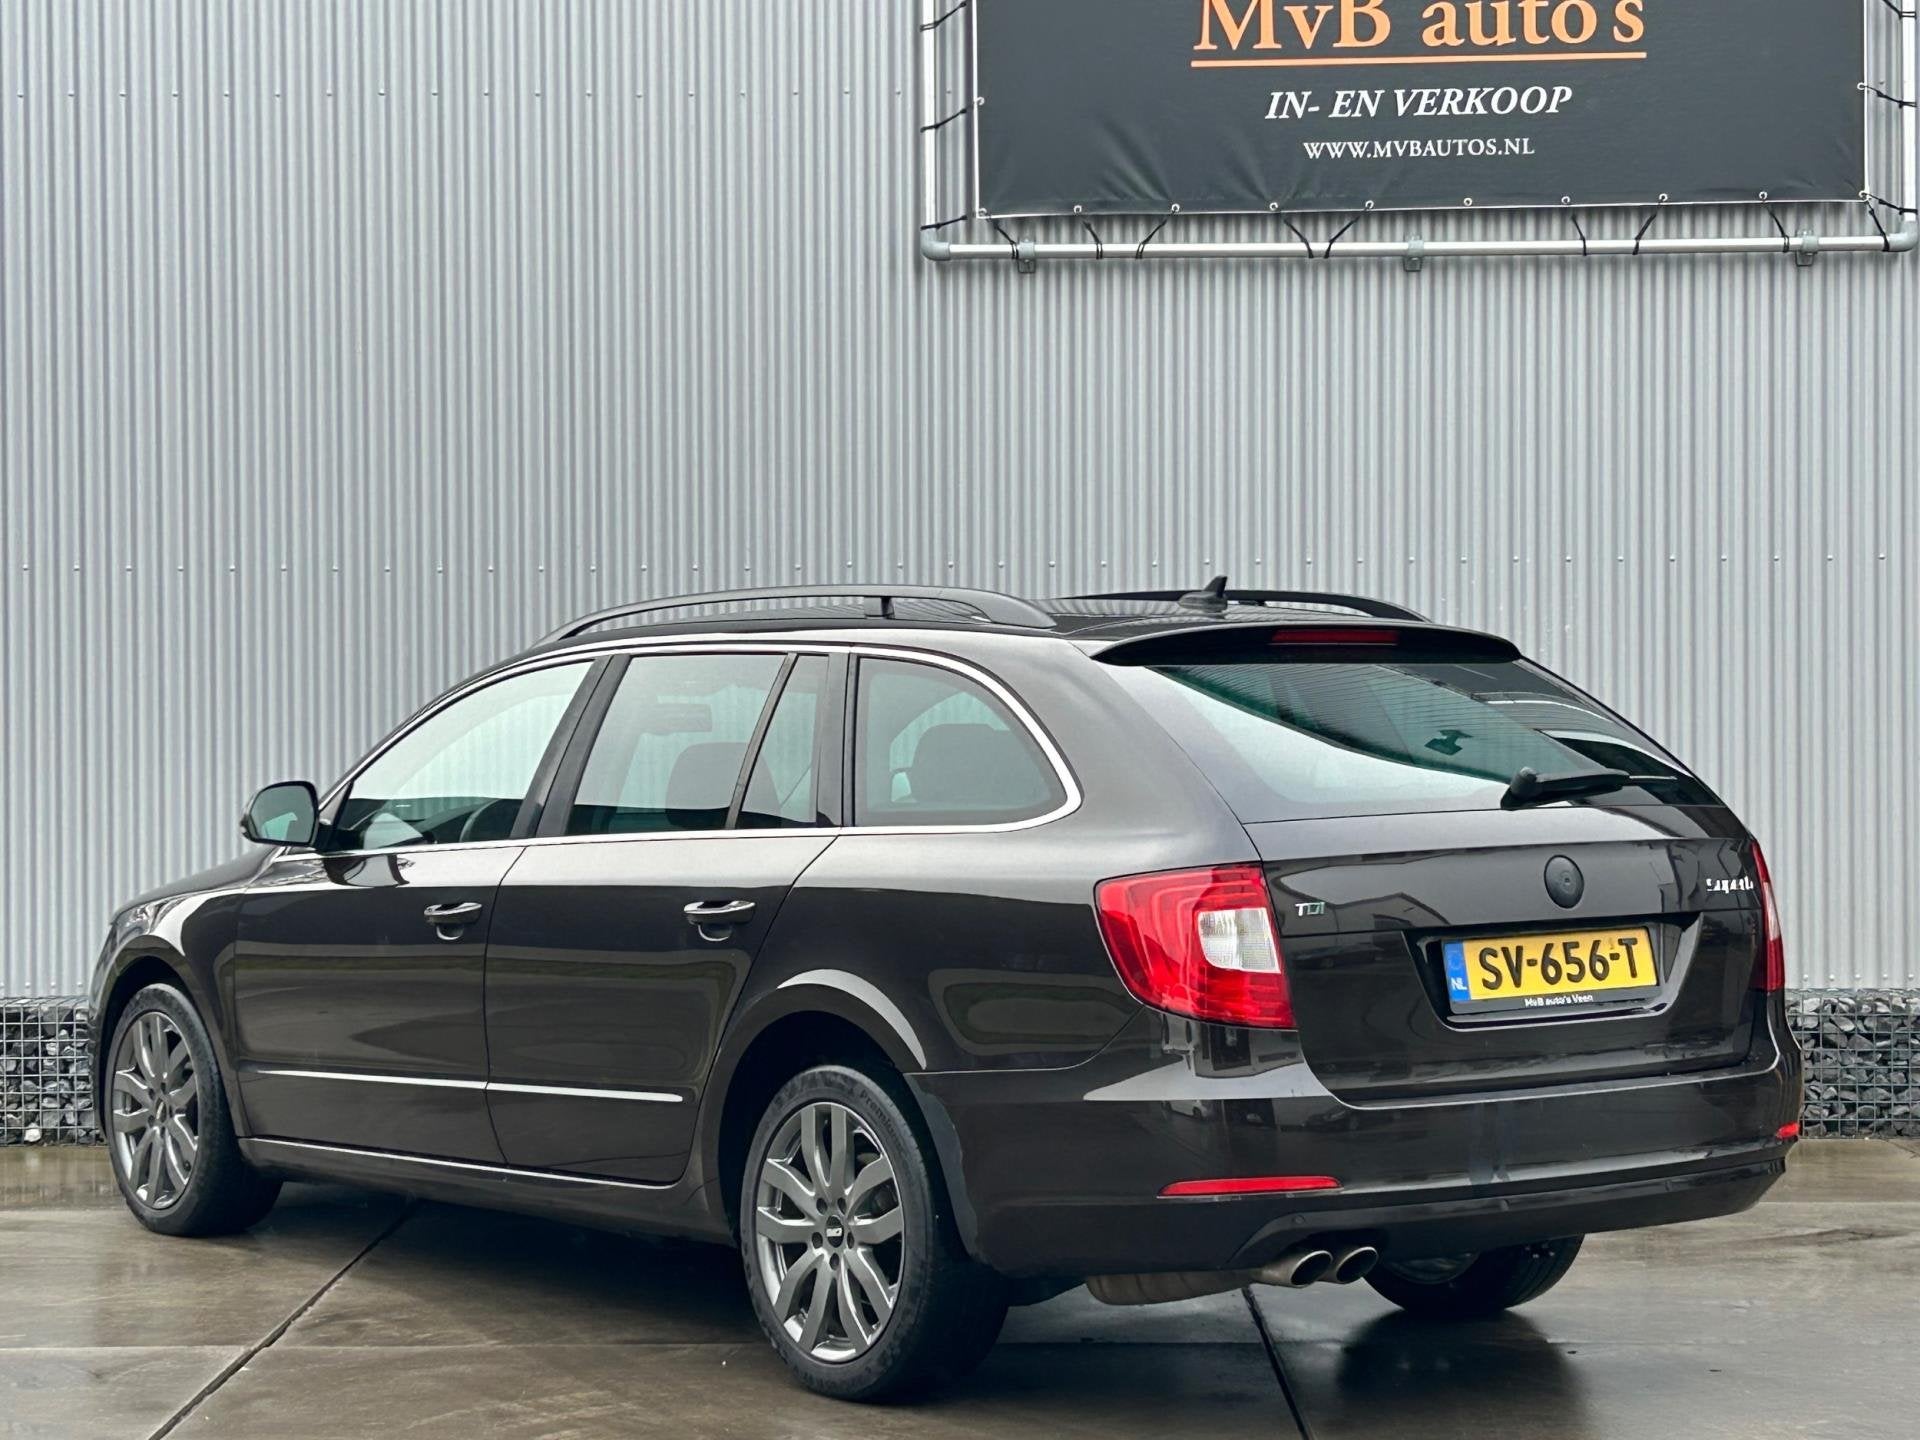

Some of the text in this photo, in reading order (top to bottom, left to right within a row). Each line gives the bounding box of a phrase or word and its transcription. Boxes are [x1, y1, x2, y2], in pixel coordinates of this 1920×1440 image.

[1193, 0, 1644, 50] MvB autos
[1265, 86, 1573, 119] IN- EN VERKOOP
[1303, 138, 1536, 160] WWW.MVBAUTOS.NL
[1479, 937, 1638, 990] SV-656-T
[1451, 977, 1467, 991] NL
